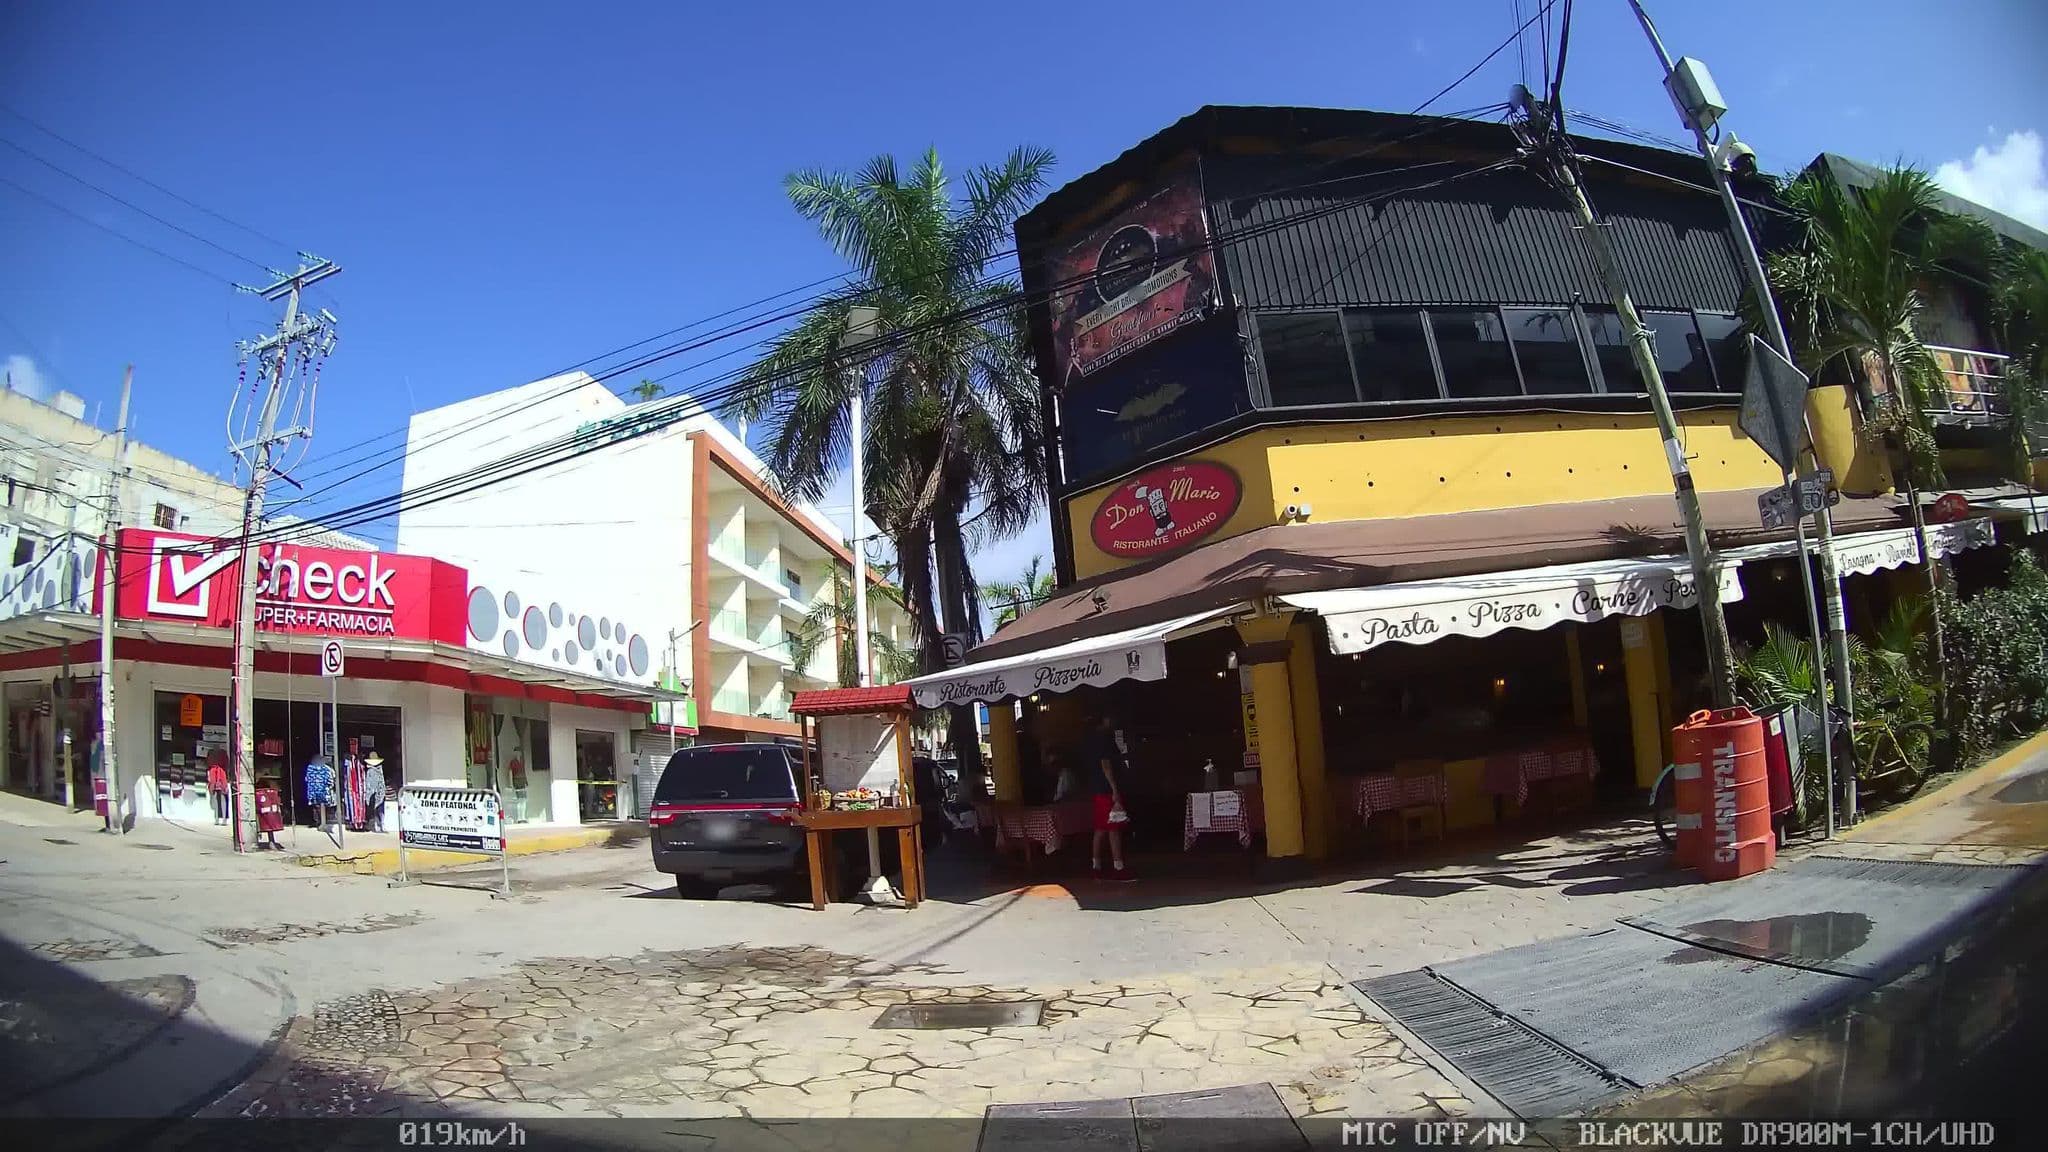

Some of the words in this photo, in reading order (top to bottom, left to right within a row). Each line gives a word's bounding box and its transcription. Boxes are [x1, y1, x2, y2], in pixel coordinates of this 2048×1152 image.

[1105, 503, 1145, 530] Don
[1169, 477, 1221, 503] Mario
[1113, 535, 1170, 550] RISTORANTE
[1174, 511, 1217, 539] ITALIANO
[255, 545, 396, 606] check
[255, 607, 395, 633] UPER+FARMACIA
[1361, 616, 1440, 646] Pasta
[1468, 600, 1542, 628] Pizza
[1572, 587, 1641, 616] Carne
[1662, 578, 1698, 603] Pes
[940, 675, 1007, 701] Ristorante
[1033, 659, 1101, 688] Pizzeria
[420, 800, 440, 809] ZONA
[440, 801, 478, 810] PEATONAL
[1712, 741, 1737, 862] TRANSITO
